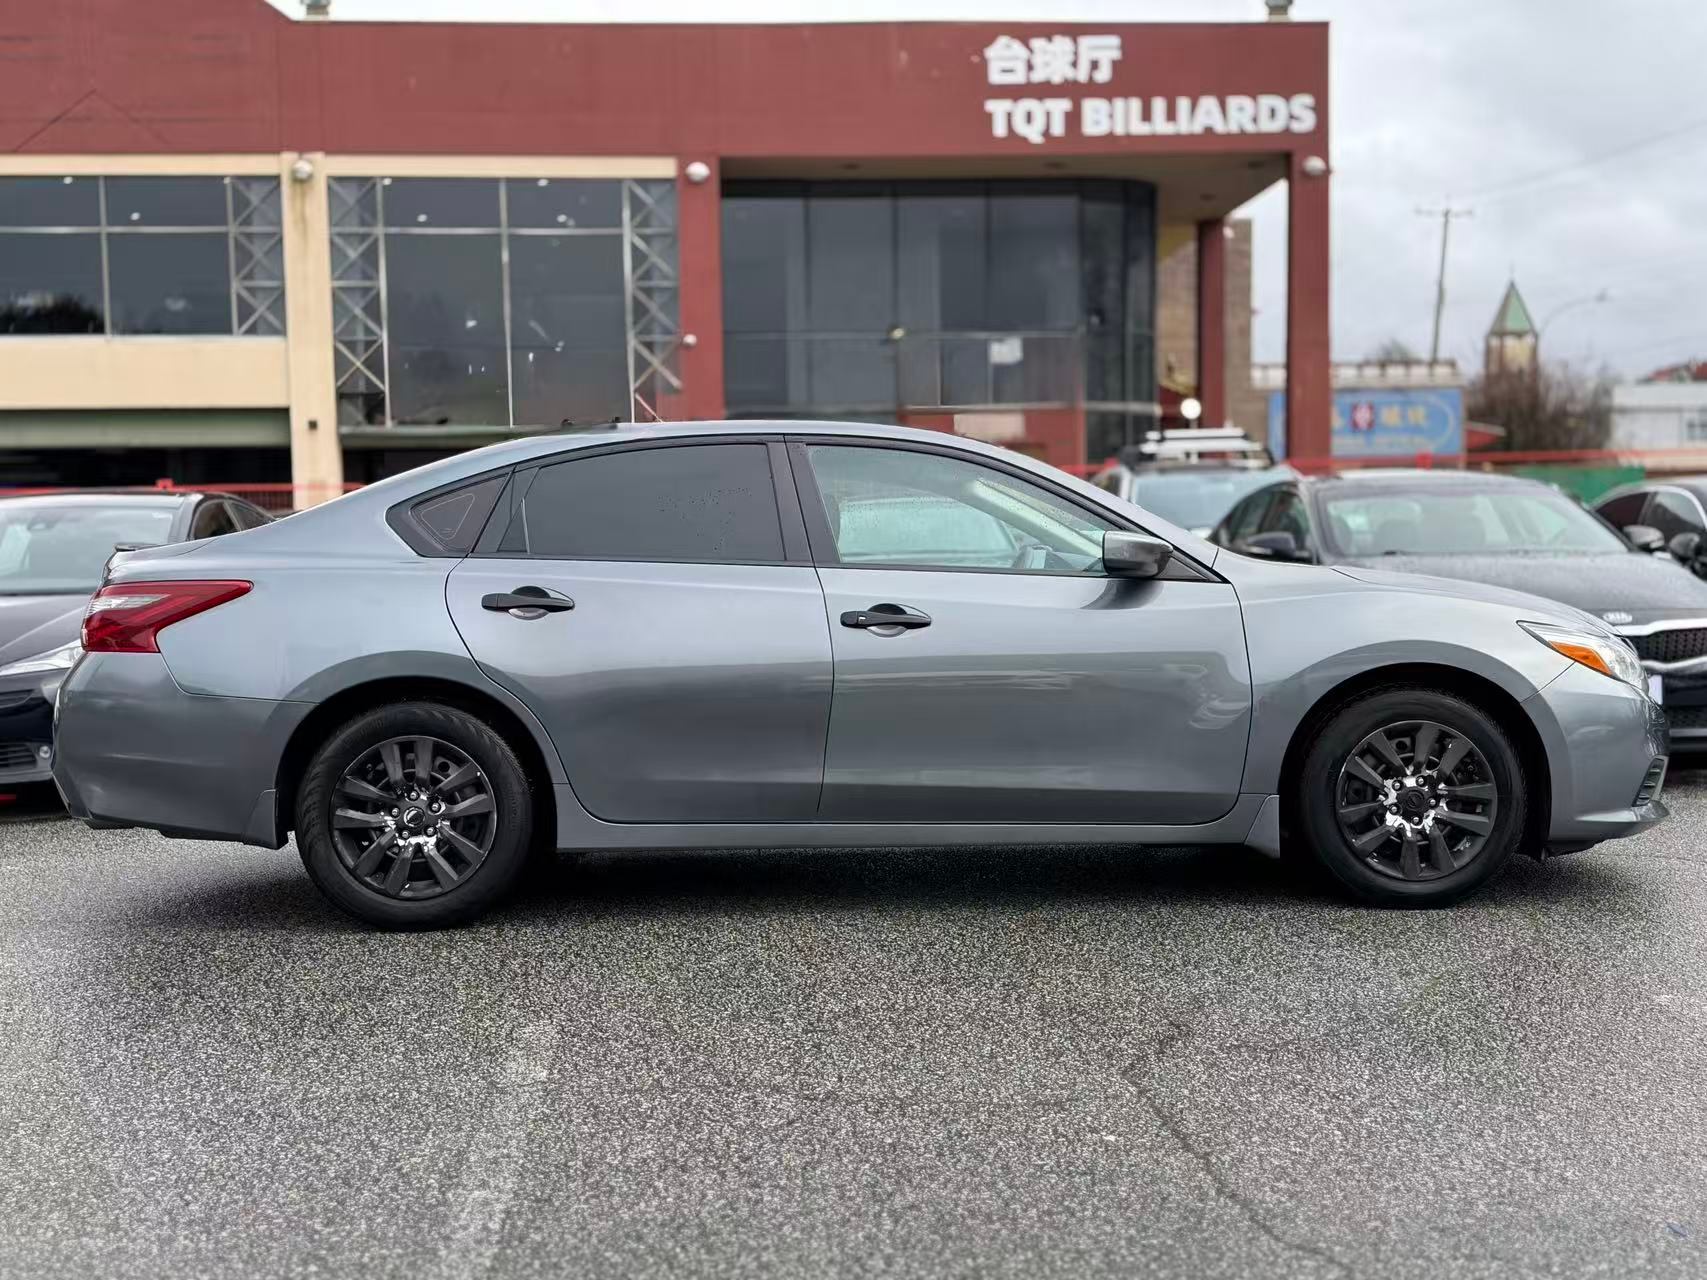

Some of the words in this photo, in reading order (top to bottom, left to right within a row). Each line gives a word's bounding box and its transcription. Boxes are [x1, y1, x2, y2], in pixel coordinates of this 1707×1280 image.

[984, 35, 1121, 85] 台球厅
[984, 98, 1072, 144] TQT
[1081, 93, 1317, 137] BILLIARDS
